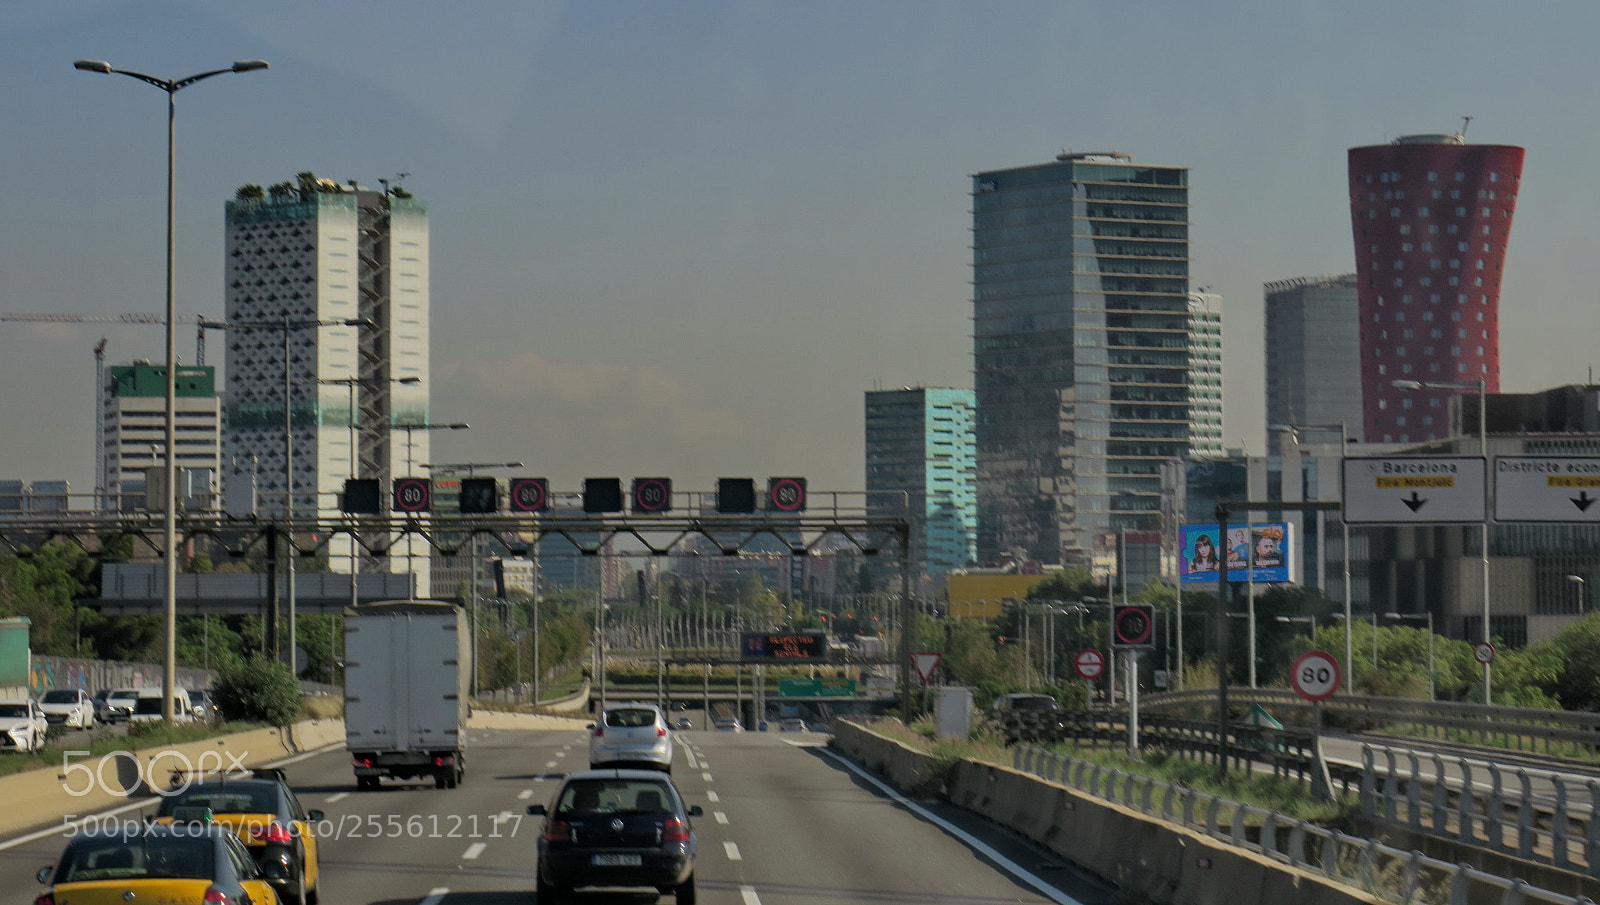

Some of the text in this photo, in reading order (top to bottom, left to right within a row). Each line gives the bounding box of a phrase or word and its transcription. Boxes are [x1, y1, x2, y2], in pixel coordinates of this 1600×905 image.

[1383, 461, 1458, 474] Barcelona
[1498, 460, 1561, 473] Districte
[404, 488, 421, 502] 80
[521, 488, 538, 502] 80
[645, 488, 661, 502] 80
[779, 488, 796, 502] 80
[1302, 667, 1330, 684] 80
